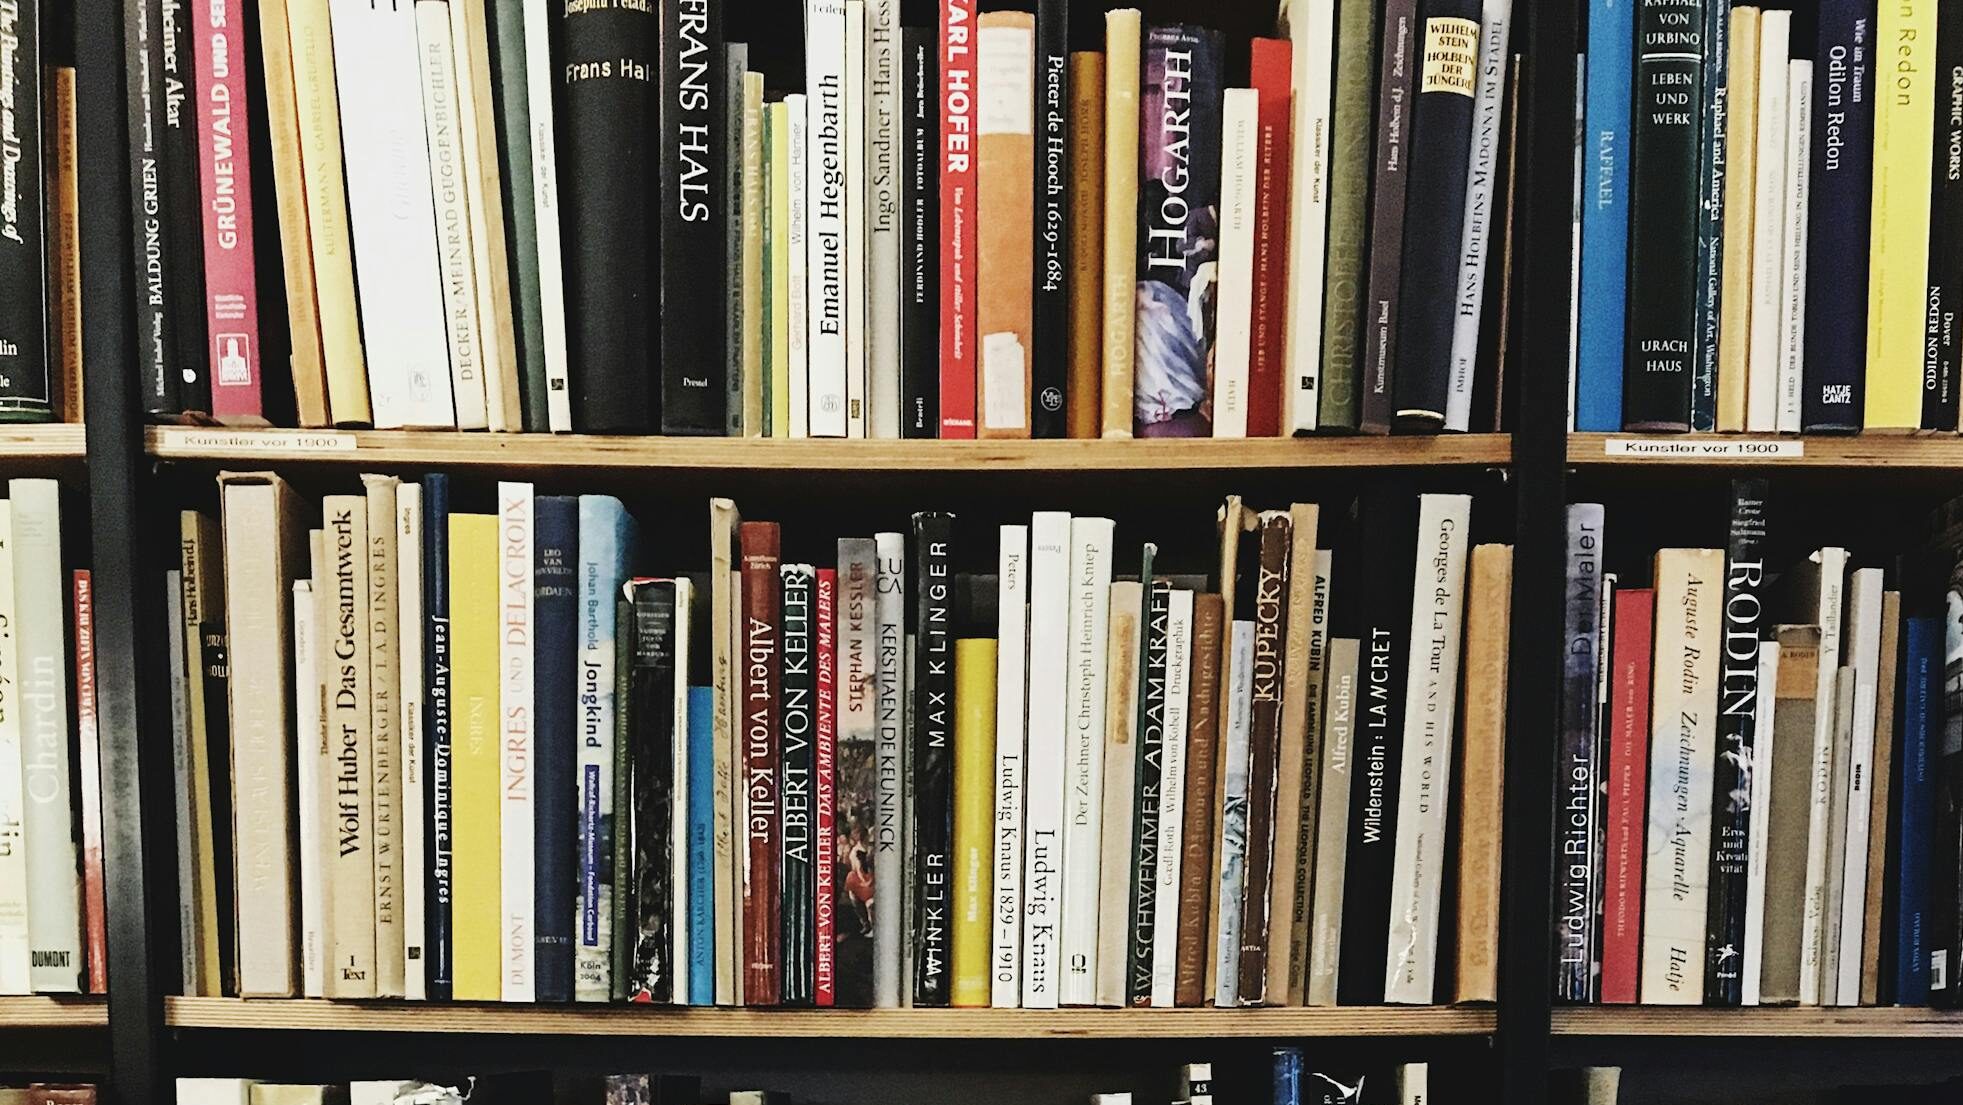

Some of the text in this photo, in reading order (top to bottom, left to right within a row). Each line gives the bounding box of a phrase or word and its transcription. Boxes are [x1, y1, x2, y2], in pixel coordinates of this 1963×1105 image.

[1393, 16, 1408, 76] Zeichnungen
[1427, 52, 1473, 65] HOLBEIN
[1429, 22, 1476, 37] WILHELM
[1438, 36, 1468, 48] STEIN
[1646, 33, 1700, 46] URBINO
[1659, 13, 1689, 25] VON
[873, 48, 891, 96] Hans
[1441, 64, 1461, 76] DER
[1652, 73, 1693, 86] LEBEN
[1656, 93, 1688, 105] UND
[1852, 19, 1866, 102] Wie im Traum
[1897, 28, 1918, 107] Redon
[165, 79, 182, 127] Altar
[212, 34, 237, 249] GRÜNEWALD UND
[680, 0, 709, 222] FRANS HALS
[947, 70, 970, 172] HOFER
[1388, 106, 1400, 143] Holbein
[1652, 112, 1690, 125] WERK
[1827, 46, 1846, 170] Odilon Redon
[1949, 66, 1963, 180] GRAPHIC WORKS
[143, 159, 160, 214] GRIEN
[873, 109, 891, 185] Sandner
[1043, 55, 1063, 291] Pieter de Hooch 1629-1684
[1148, 47, 1192, 271] HOGARTH
[1387, 145, 1398, 171] Hans
[1461, 19, 1504, 316] HANS HOLBEINS MADONNA IM STÄDEL
[1600, 131, 1613, 209] RAFFAEL
[1709, 87, 1726, 220] Raphael and America
[818, 74, 844, 336] Emanuel Hegenbarth
[873, 190, 896, 233] Ingo
[145, 219, 164, 305] BALDUNG
[1110, 273, 1127, 376] HOGARTH
[1377, 300, 1390, 323] Basel
[1642, 340, 1687, 353] URACH
[1925, 286, 1941, 389] ODILON REDON
[1943, 312, 1953, 345] Dover
[1374, 326, 1390, 393] Kunstmuseum
[1646, 360, 1681, 373] HAUS
[1823, 385, 1851, 395] HATJE
[1823, 394, 1851, 404] CANTZ
[260, 437, 289, 449] vor
[295, 436, 339, 449] 1900
[1700, 443, 1730, 454] vor
[1736, 442, 1780, 455] 1900
[404, 507, 412, 534] Ingres
[1576, 523, 1595, 601] Maler
[848, 562, 864, 712] STEPHAN KESSLER
[1148, 586, 1168, 667] KRAFT
[1254, 567, 1280, 700] KUPECKY
[1681, 572, 1704, 639] Auguste
[1722, 557, 1763, 720] RODIN
[332, 510, 358, 857] Wolf Huber Das Gesamtwerk
[506, 497, 527, 801] INGRES UND DELACROIX
[581, 562, 602, 747] Johan Barthold Jongkind
[1075, 543, 1098, 826] Der Zeichner Christoph Heinrich Kniep
[1419, 518, 1455, 813] Georges de La Tour AND HIS WORLD
[1681, 646, 1700, 694] Rodin
[24, 655, 61, 802] Chardin
[470, 696, 483, 755] INGRES
[750, 618, 772, 843] Albert von Keller
[784, 573, 808, 862] ALBERT VON KELLER
[879, 623, 897, 852] KERSTIAEN DE KEUNINCK
[927, 541, 947, 974] WINKLER MAX KLINGER
[1145, 677, 1165, 768] ADAM
[1296, 575, 1326, 923] ALFRED KUBIN DIE SAMMLUNG LEOPOLD THE LEOPOLD COLLECTION
[1332, 674, 1353, 774] Alfred Kubin
[1364, 627, 1390, 843] Wildenstein LANCRET
[433, 616, 452, 904] Jean-Auguste-Dominique Ingres
[818, 580, 831, 993] ALBERT VON KELLER DAS AMBIENTE DES MALERS
[1674, 712, 1698, 811] Zeichnungen
[1564, 754, 1589, 855] Richter
[1137, 784, 1158, 958] SCHWEMMER
[1671, 823, 1690, 900] Aquarelle
[510, 913, 525, 985] DUMONT
[1028, 829, 1054, 992] Ludwig Knaus
[1561, 864, 1589, 963] Ludwig
[32, 950, 70, 968] DUMONT
[580, 960, 602, 971] Köln
[1668, 947, 1687, 991] Hatje
[1195, 1083, 1207, 1093] 43
